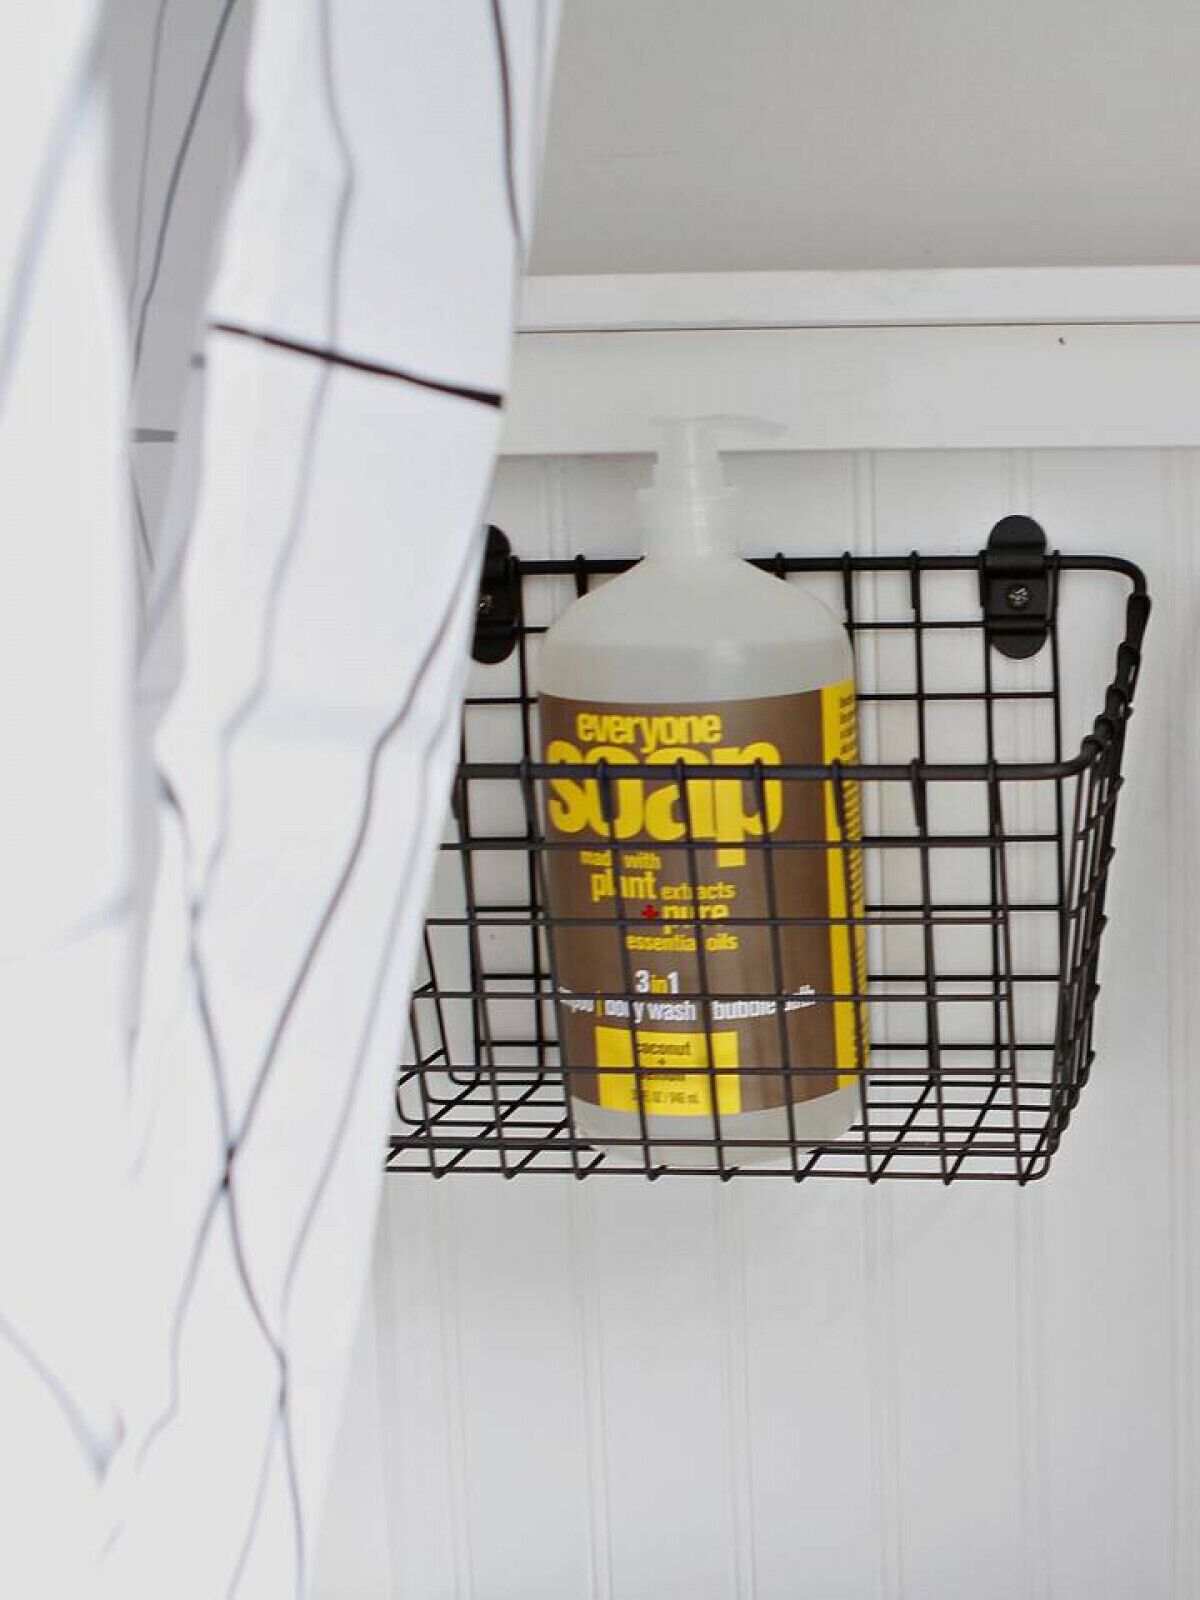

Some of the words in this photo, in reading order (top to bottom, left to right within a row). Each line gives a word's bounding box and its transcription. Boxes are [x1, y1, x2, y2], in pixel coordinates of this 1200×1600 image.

[576, 712, 722, 753] everyone
[547, 740, 783, 868] soap
[626, 934, 698, 952] essentia
